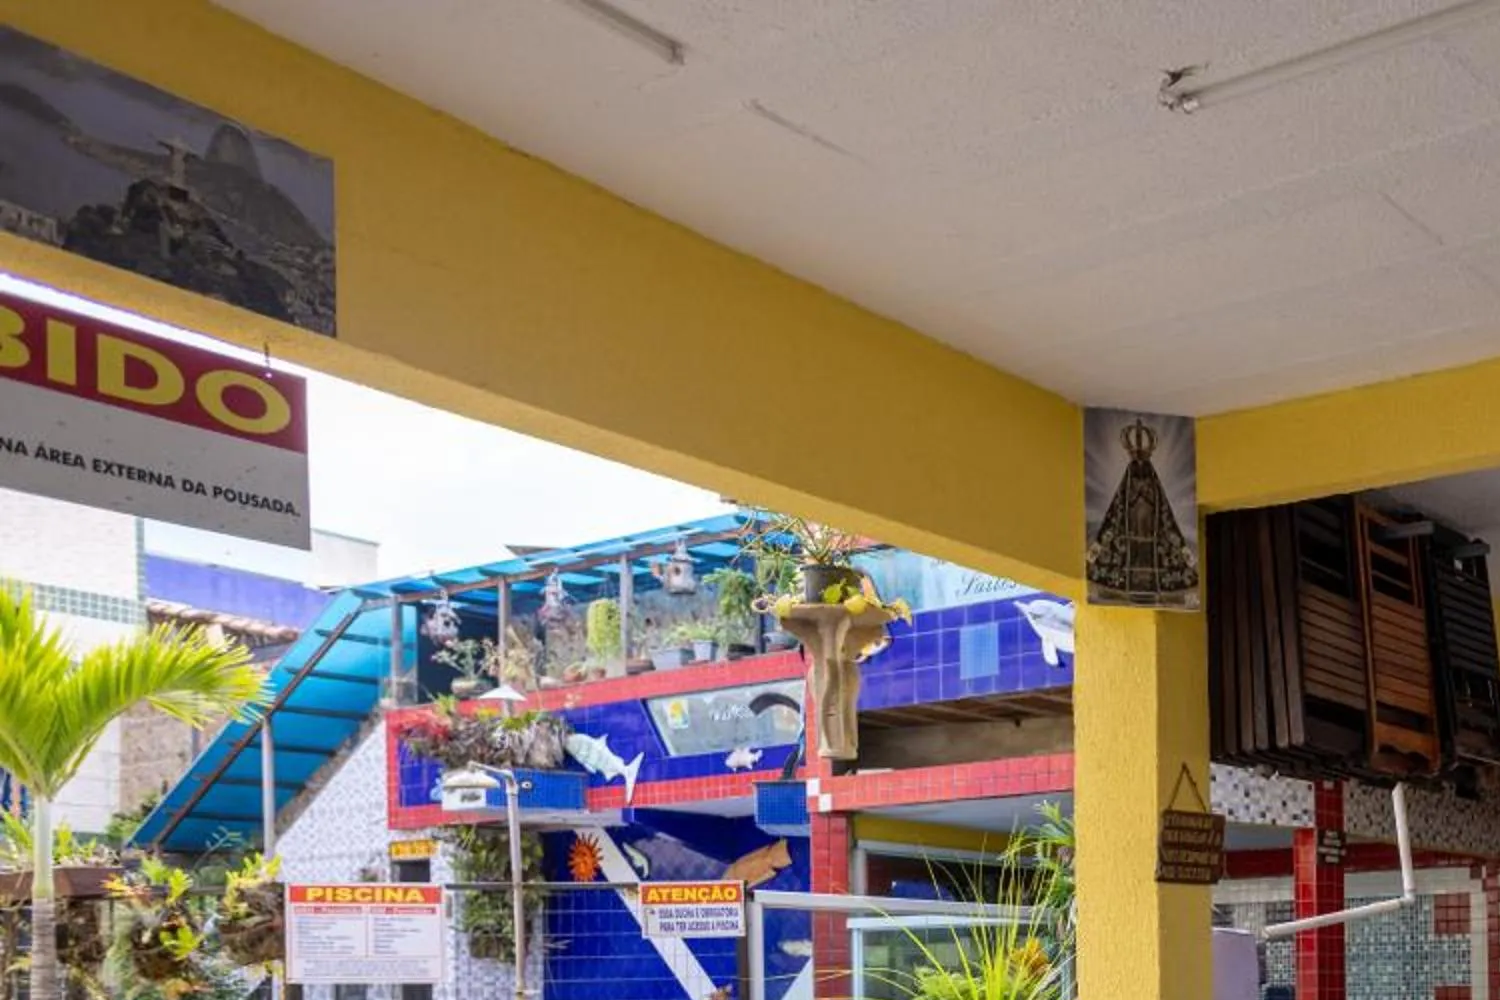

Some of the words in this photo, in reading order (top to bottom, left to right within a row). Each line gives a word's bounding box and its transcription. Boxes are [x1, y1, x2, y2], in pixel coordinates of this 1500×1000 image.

[34, 441, 86, 470] ÁREA
[92, 458, 175, 490] EXTERNA
[181, 478, 207, 497] DA
[212, 485, 302, 518] POUSADA.
[305, 886, 426, 902] PISCINA
[647, 885, 737, 904] ATENÇÃO
